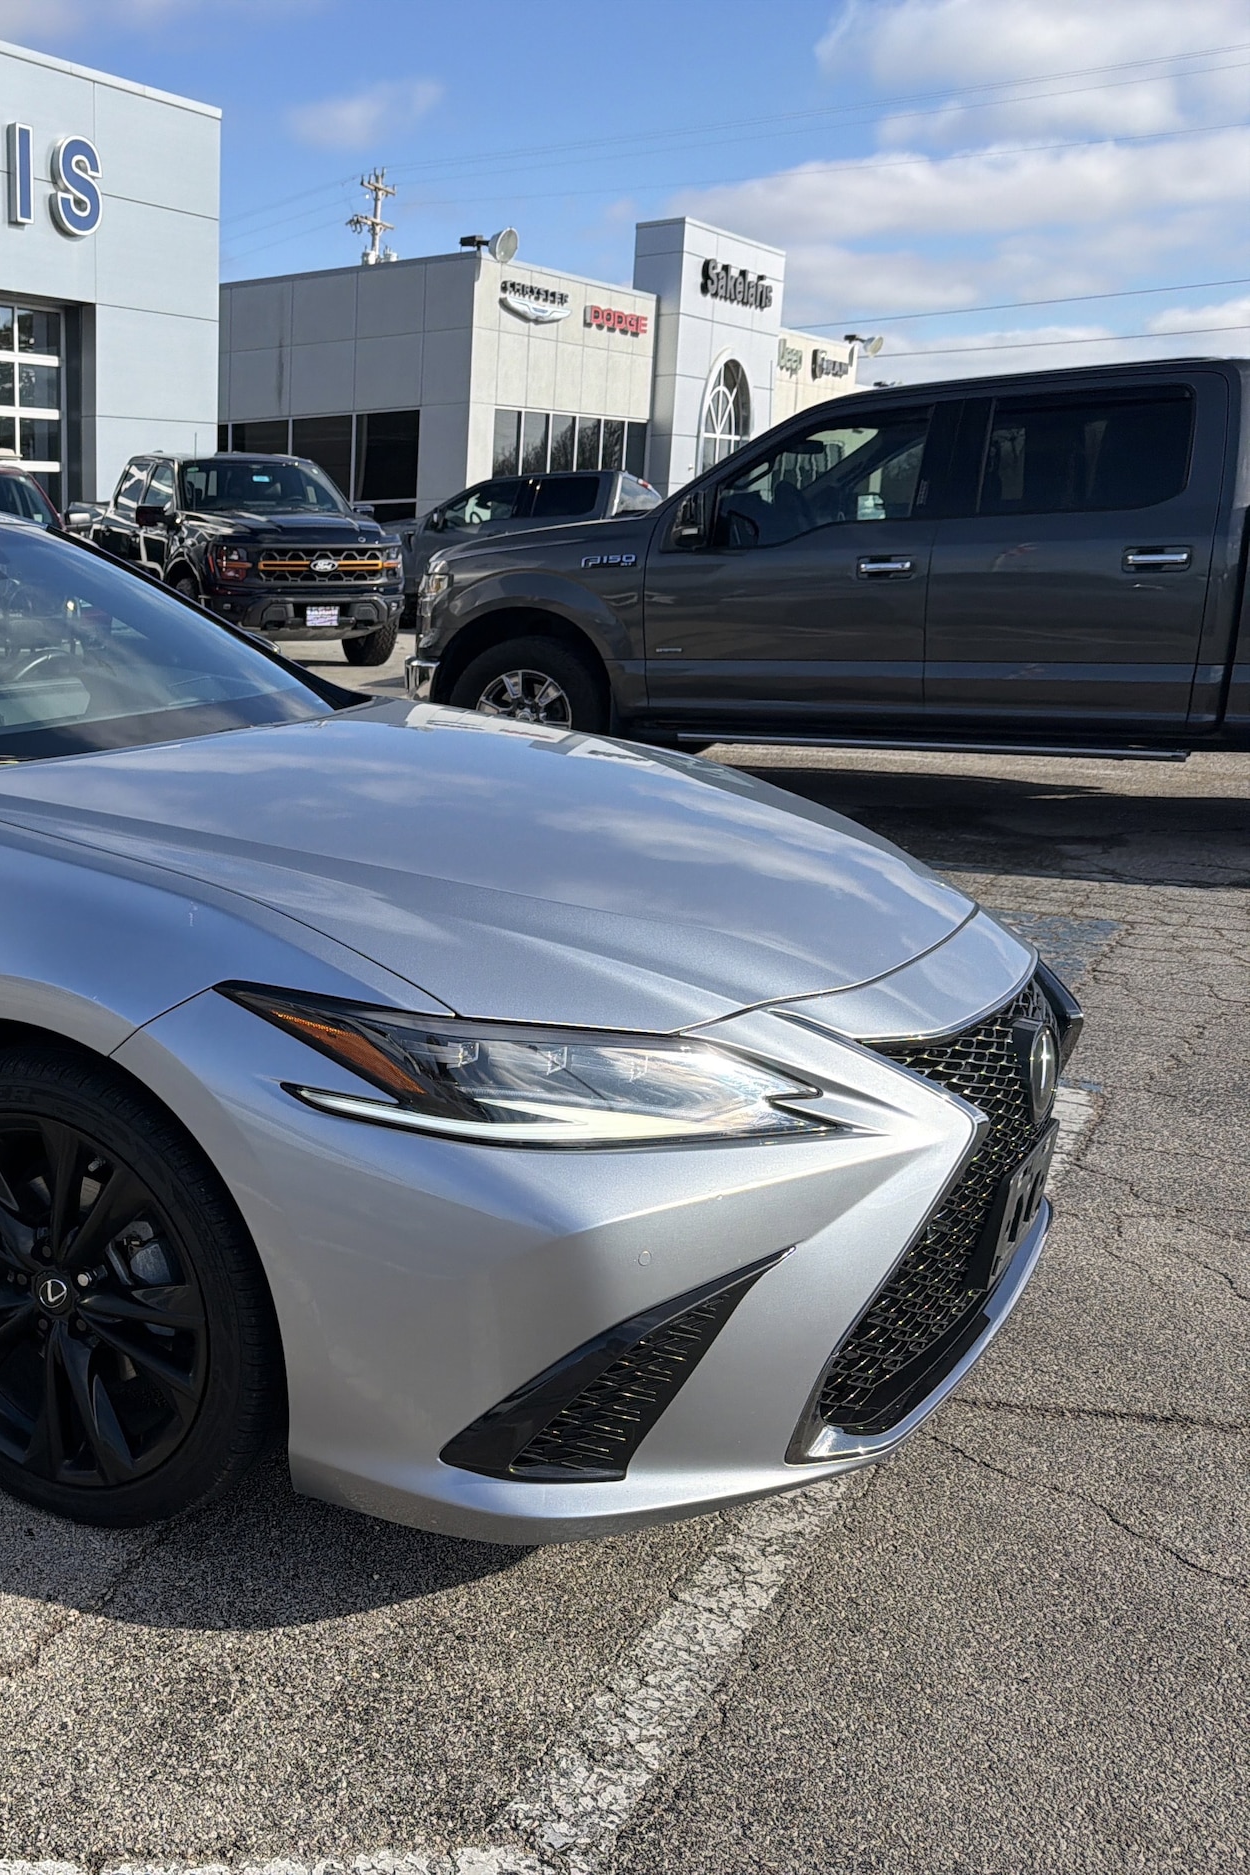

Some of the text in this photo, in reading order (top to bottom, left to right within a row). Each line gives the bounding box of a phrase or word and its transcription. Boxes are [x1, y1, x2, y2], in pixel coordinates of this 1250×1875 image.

[501, 280, 569, 306] CHRYSLER
[701, 258, 773, 310] Sakelaris
[587, 305, 648, 335] DODGE
[778, 338, 803, 377] Jeep
